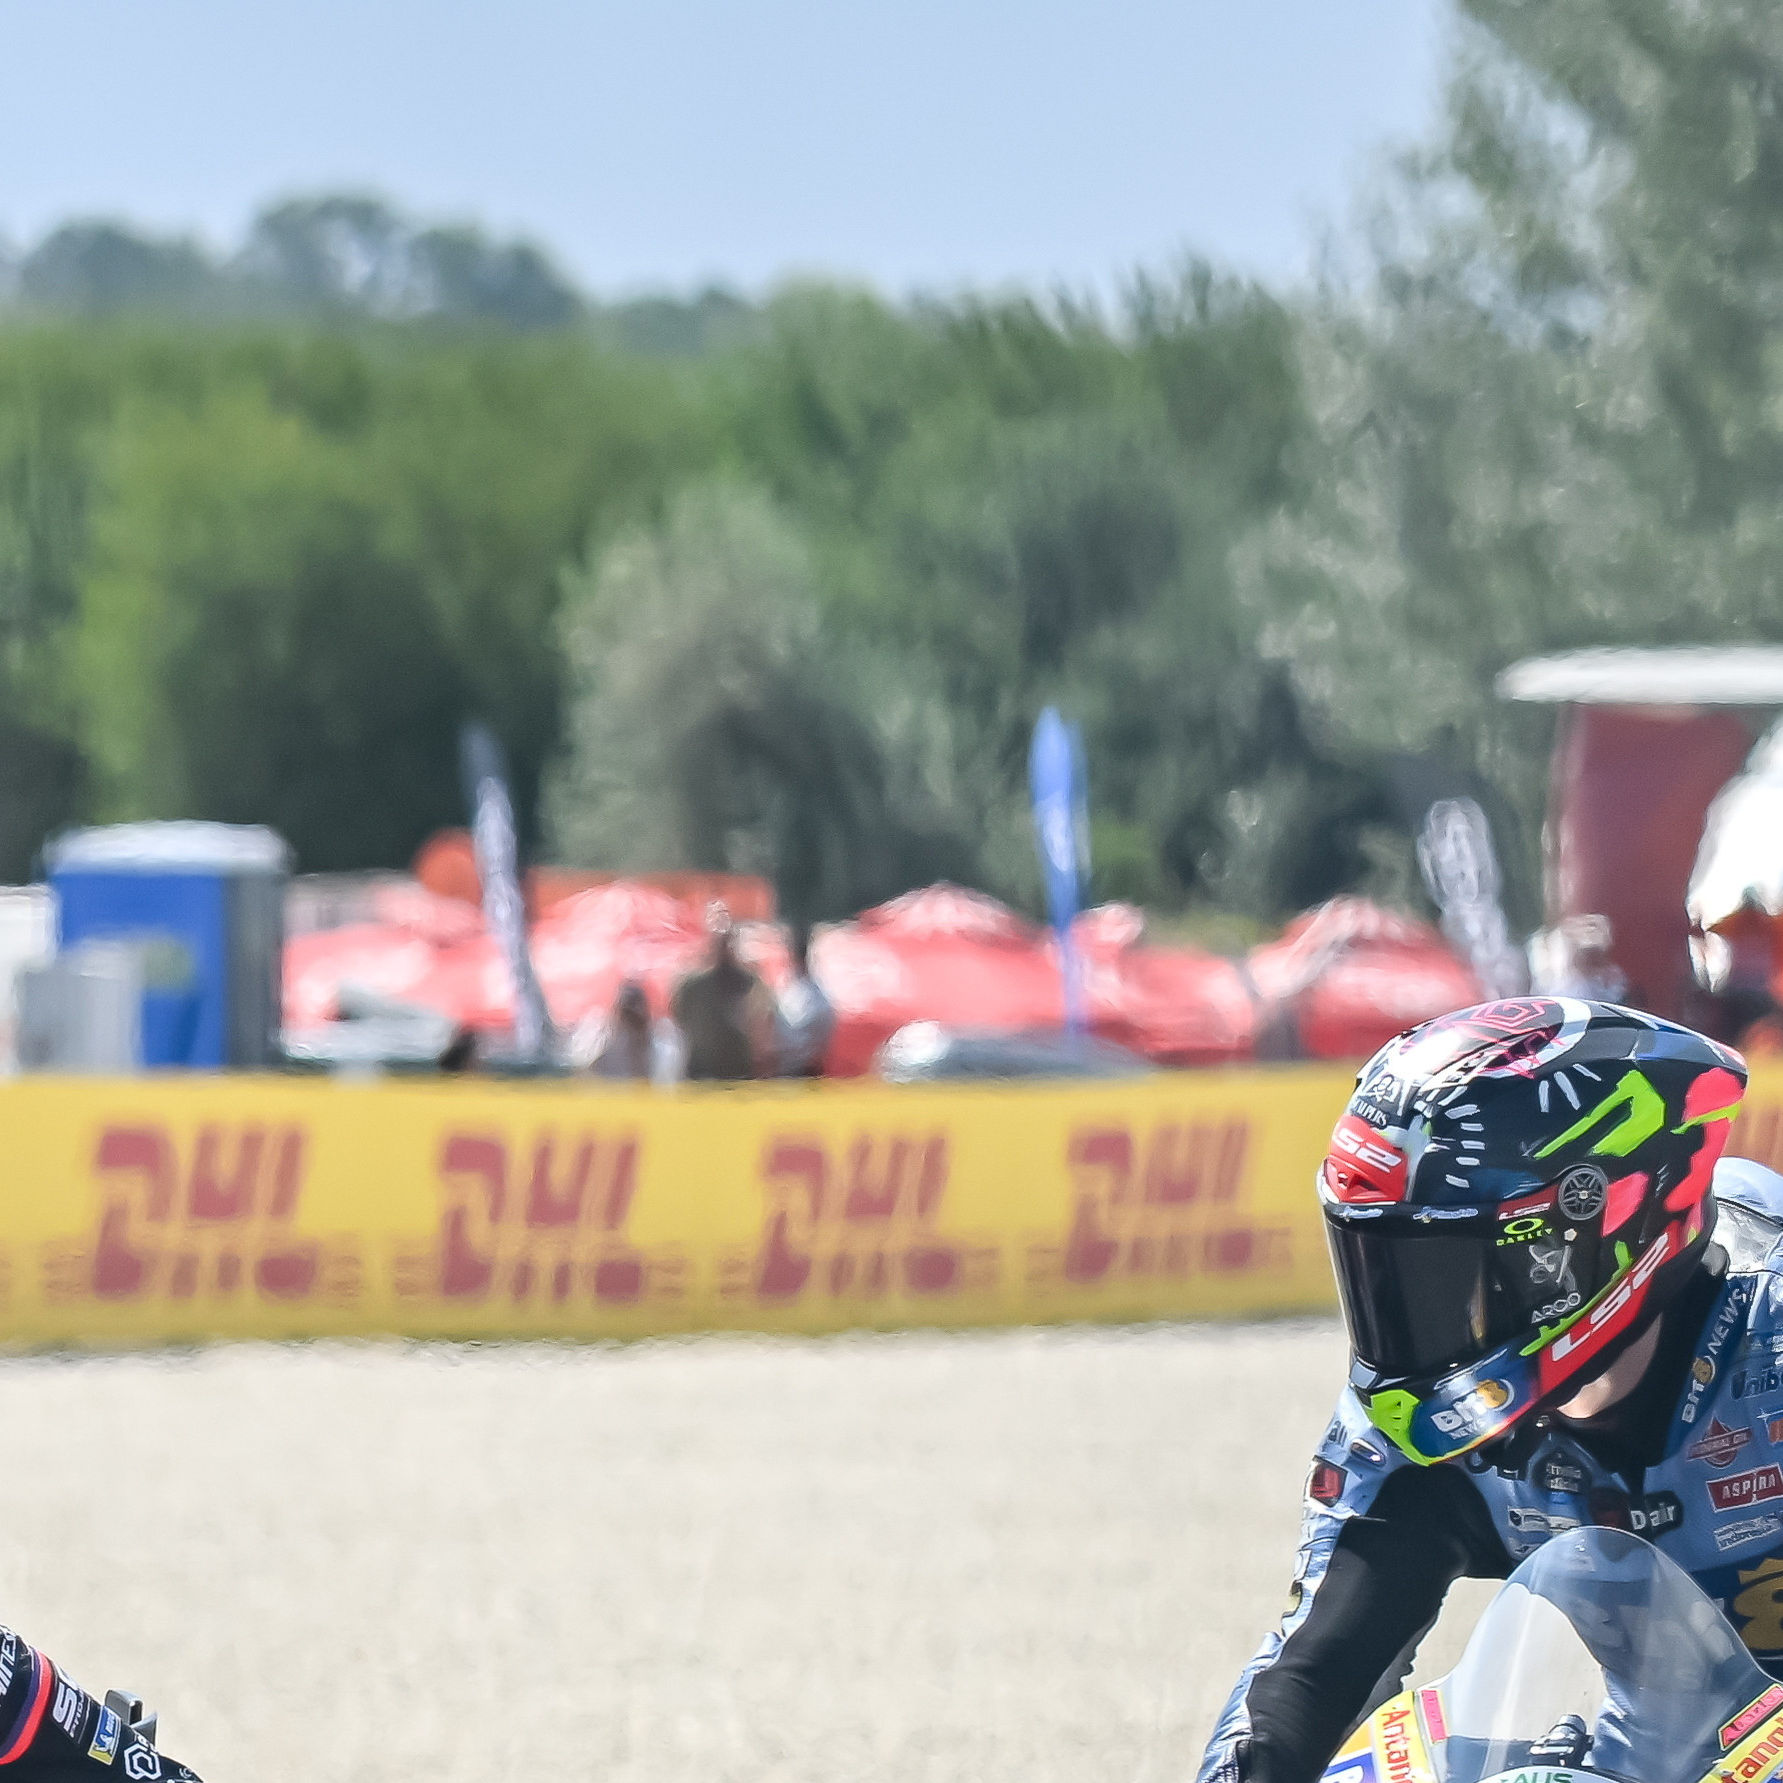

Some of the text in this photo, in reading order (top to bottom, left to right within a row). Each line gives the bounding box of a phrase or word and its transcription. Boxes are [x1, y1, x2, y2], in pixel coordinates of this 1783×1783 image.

[84, 1122, 322, 1302] DHL
[433, 1128, 649, 1310] DHL
[754, 1125, 957, 1300] DHL
[1059, 1115, 1269, 1278] DHL
[1496, 1227, 1553, 1246] OAKLEY
[1552, 1232, 1670, 1362] LS2
[1722, 1473, 1777, 1500] ASPIRA
